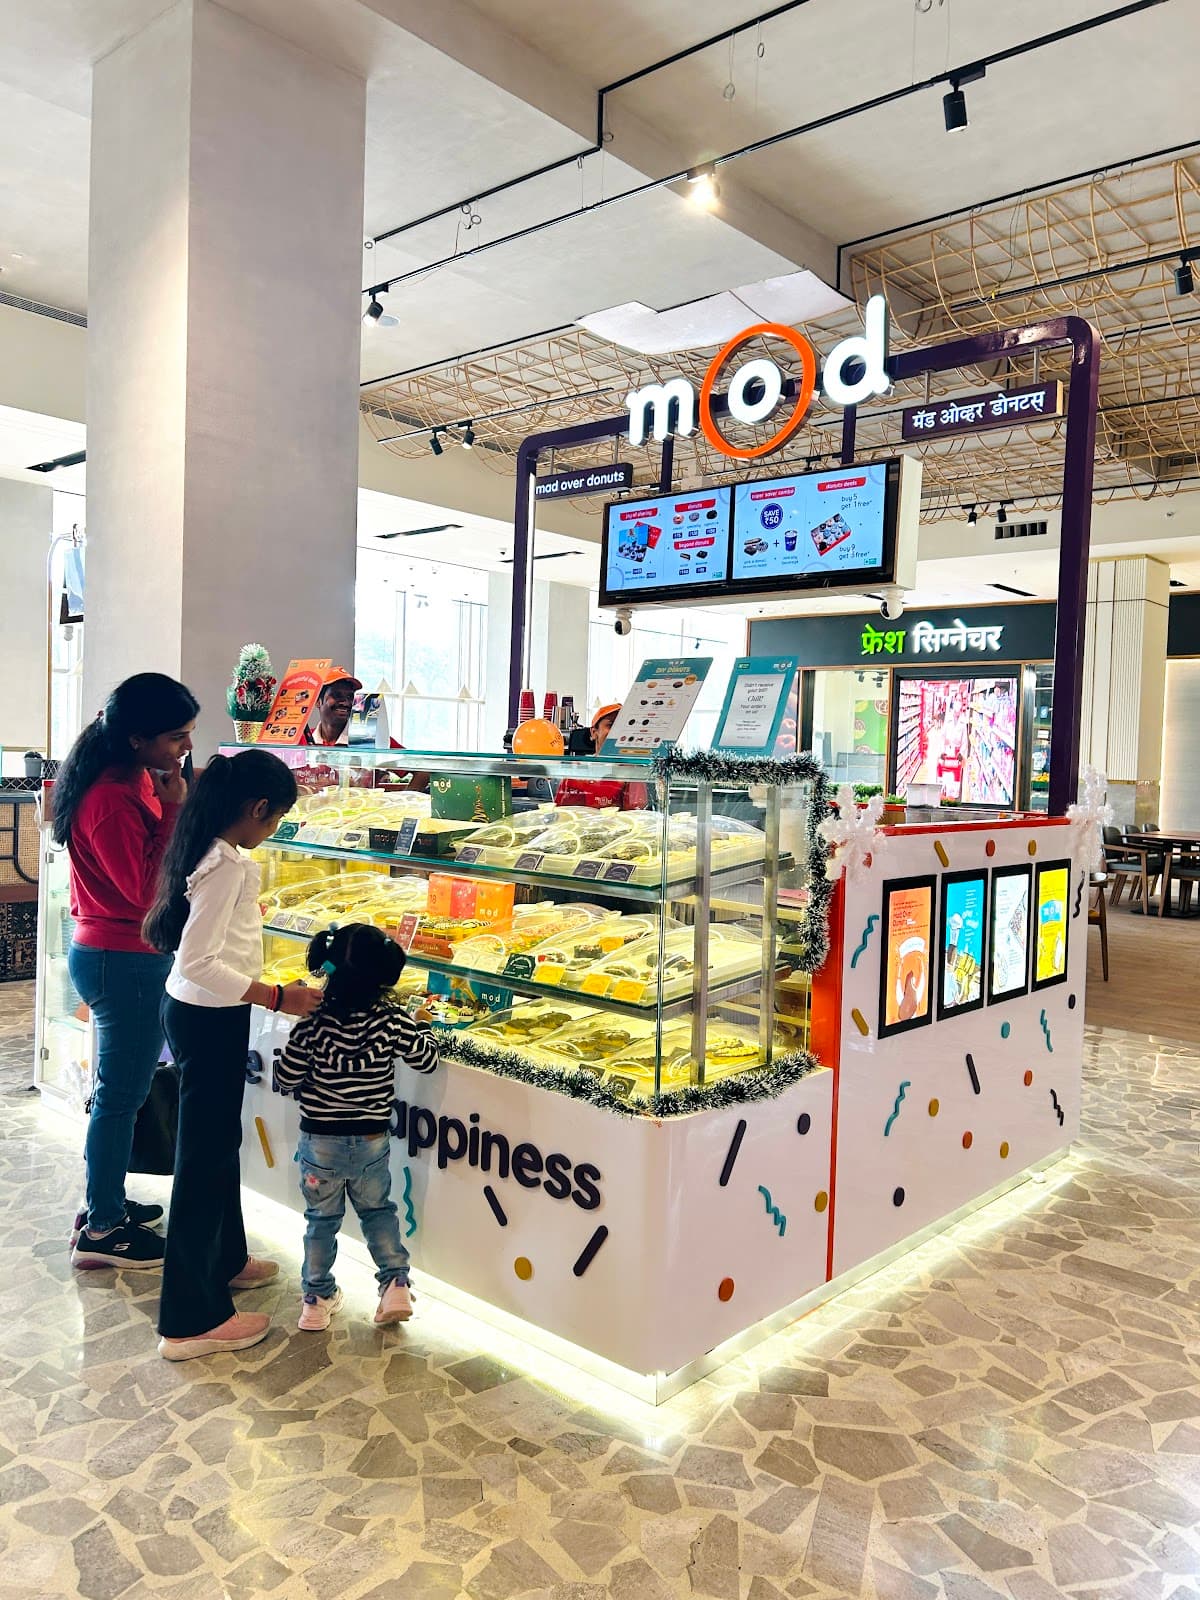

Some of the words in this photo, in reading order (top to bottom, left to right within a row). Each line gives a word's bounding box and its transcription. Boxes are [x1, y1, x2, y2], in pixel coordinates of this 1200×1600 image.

[626, 294, 890, 447] mod
[912, 410, 937, 429] मॅड
[940, 402, 985, 424] ओव्हर
[989, 391, 1046, 416] डोनटस्
[535, 480, 558, 495] mad
[560, 478, 585, 491] over
[586, 471, 625, 487] donuts
[841, 495, 852, 503] buy
[840, 502, 851, 511] get
[763, 509, 780, 517] SAVE
[765, 516, 779, 525] ₹50
[839, 546, 852, 554] buy
[851, 544, 856, 552] 9
[838, 552, 849, 561] get
[861, 624, 906, 655] फ्रेश
[912, 618, 1004, 654] सिग्नेचर
[773, 661, 793, 669] mod
[433, 778, 451, 789] mod
[480, 907, 499, 918] mod
[481, 992, 501, 1006] mod
[389, 1098, 601, 1210] appiness
